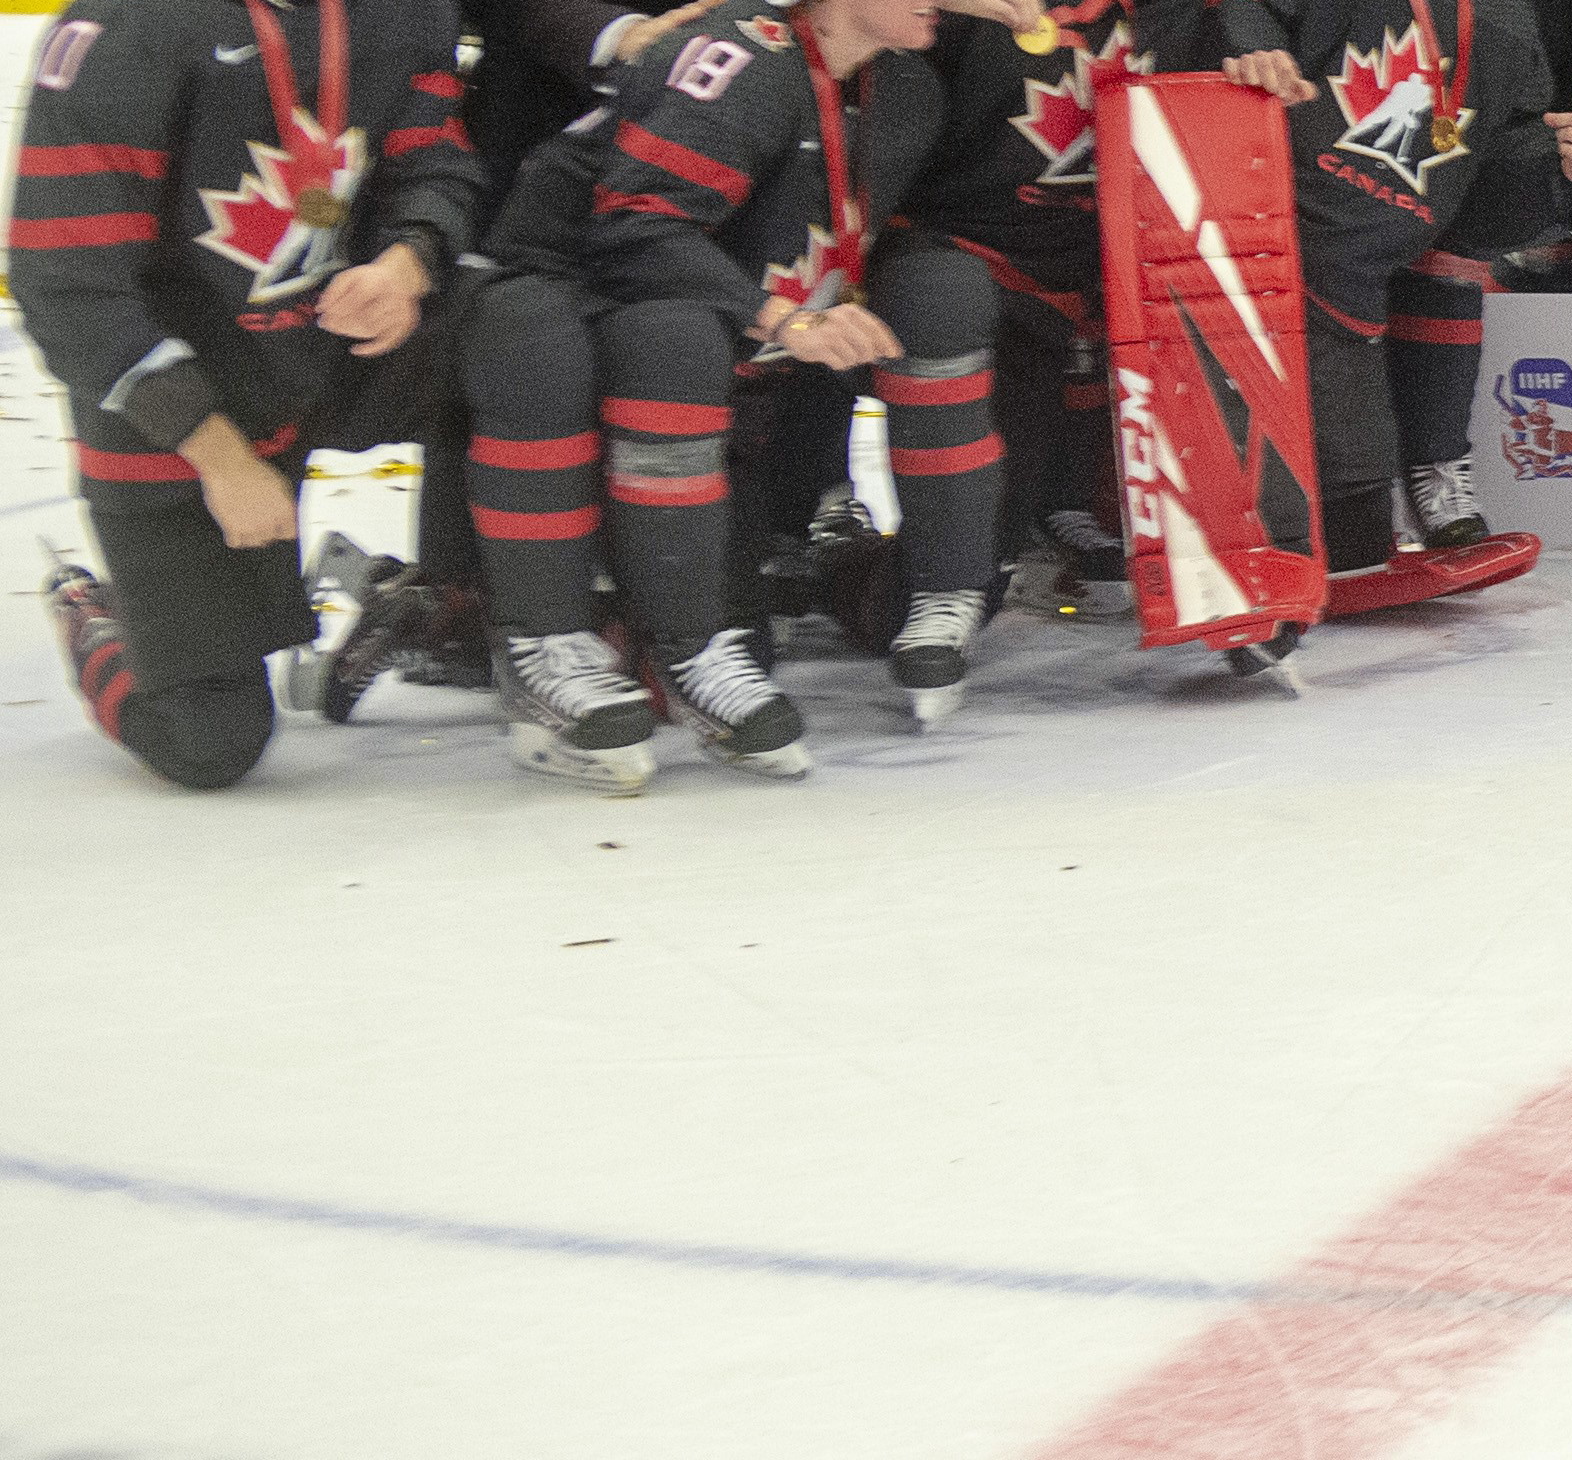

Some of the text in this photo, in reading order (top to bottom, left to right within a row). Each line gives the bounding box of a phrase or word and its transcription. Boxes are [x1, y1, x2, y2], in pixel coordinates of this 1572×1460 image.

[665, 35, 755, 101] 18
[1316, 152, 1434, 224] CANADA
[1518, 372, 1566, 389] IIHF
[1118, 367, 1162, 539] CCM
